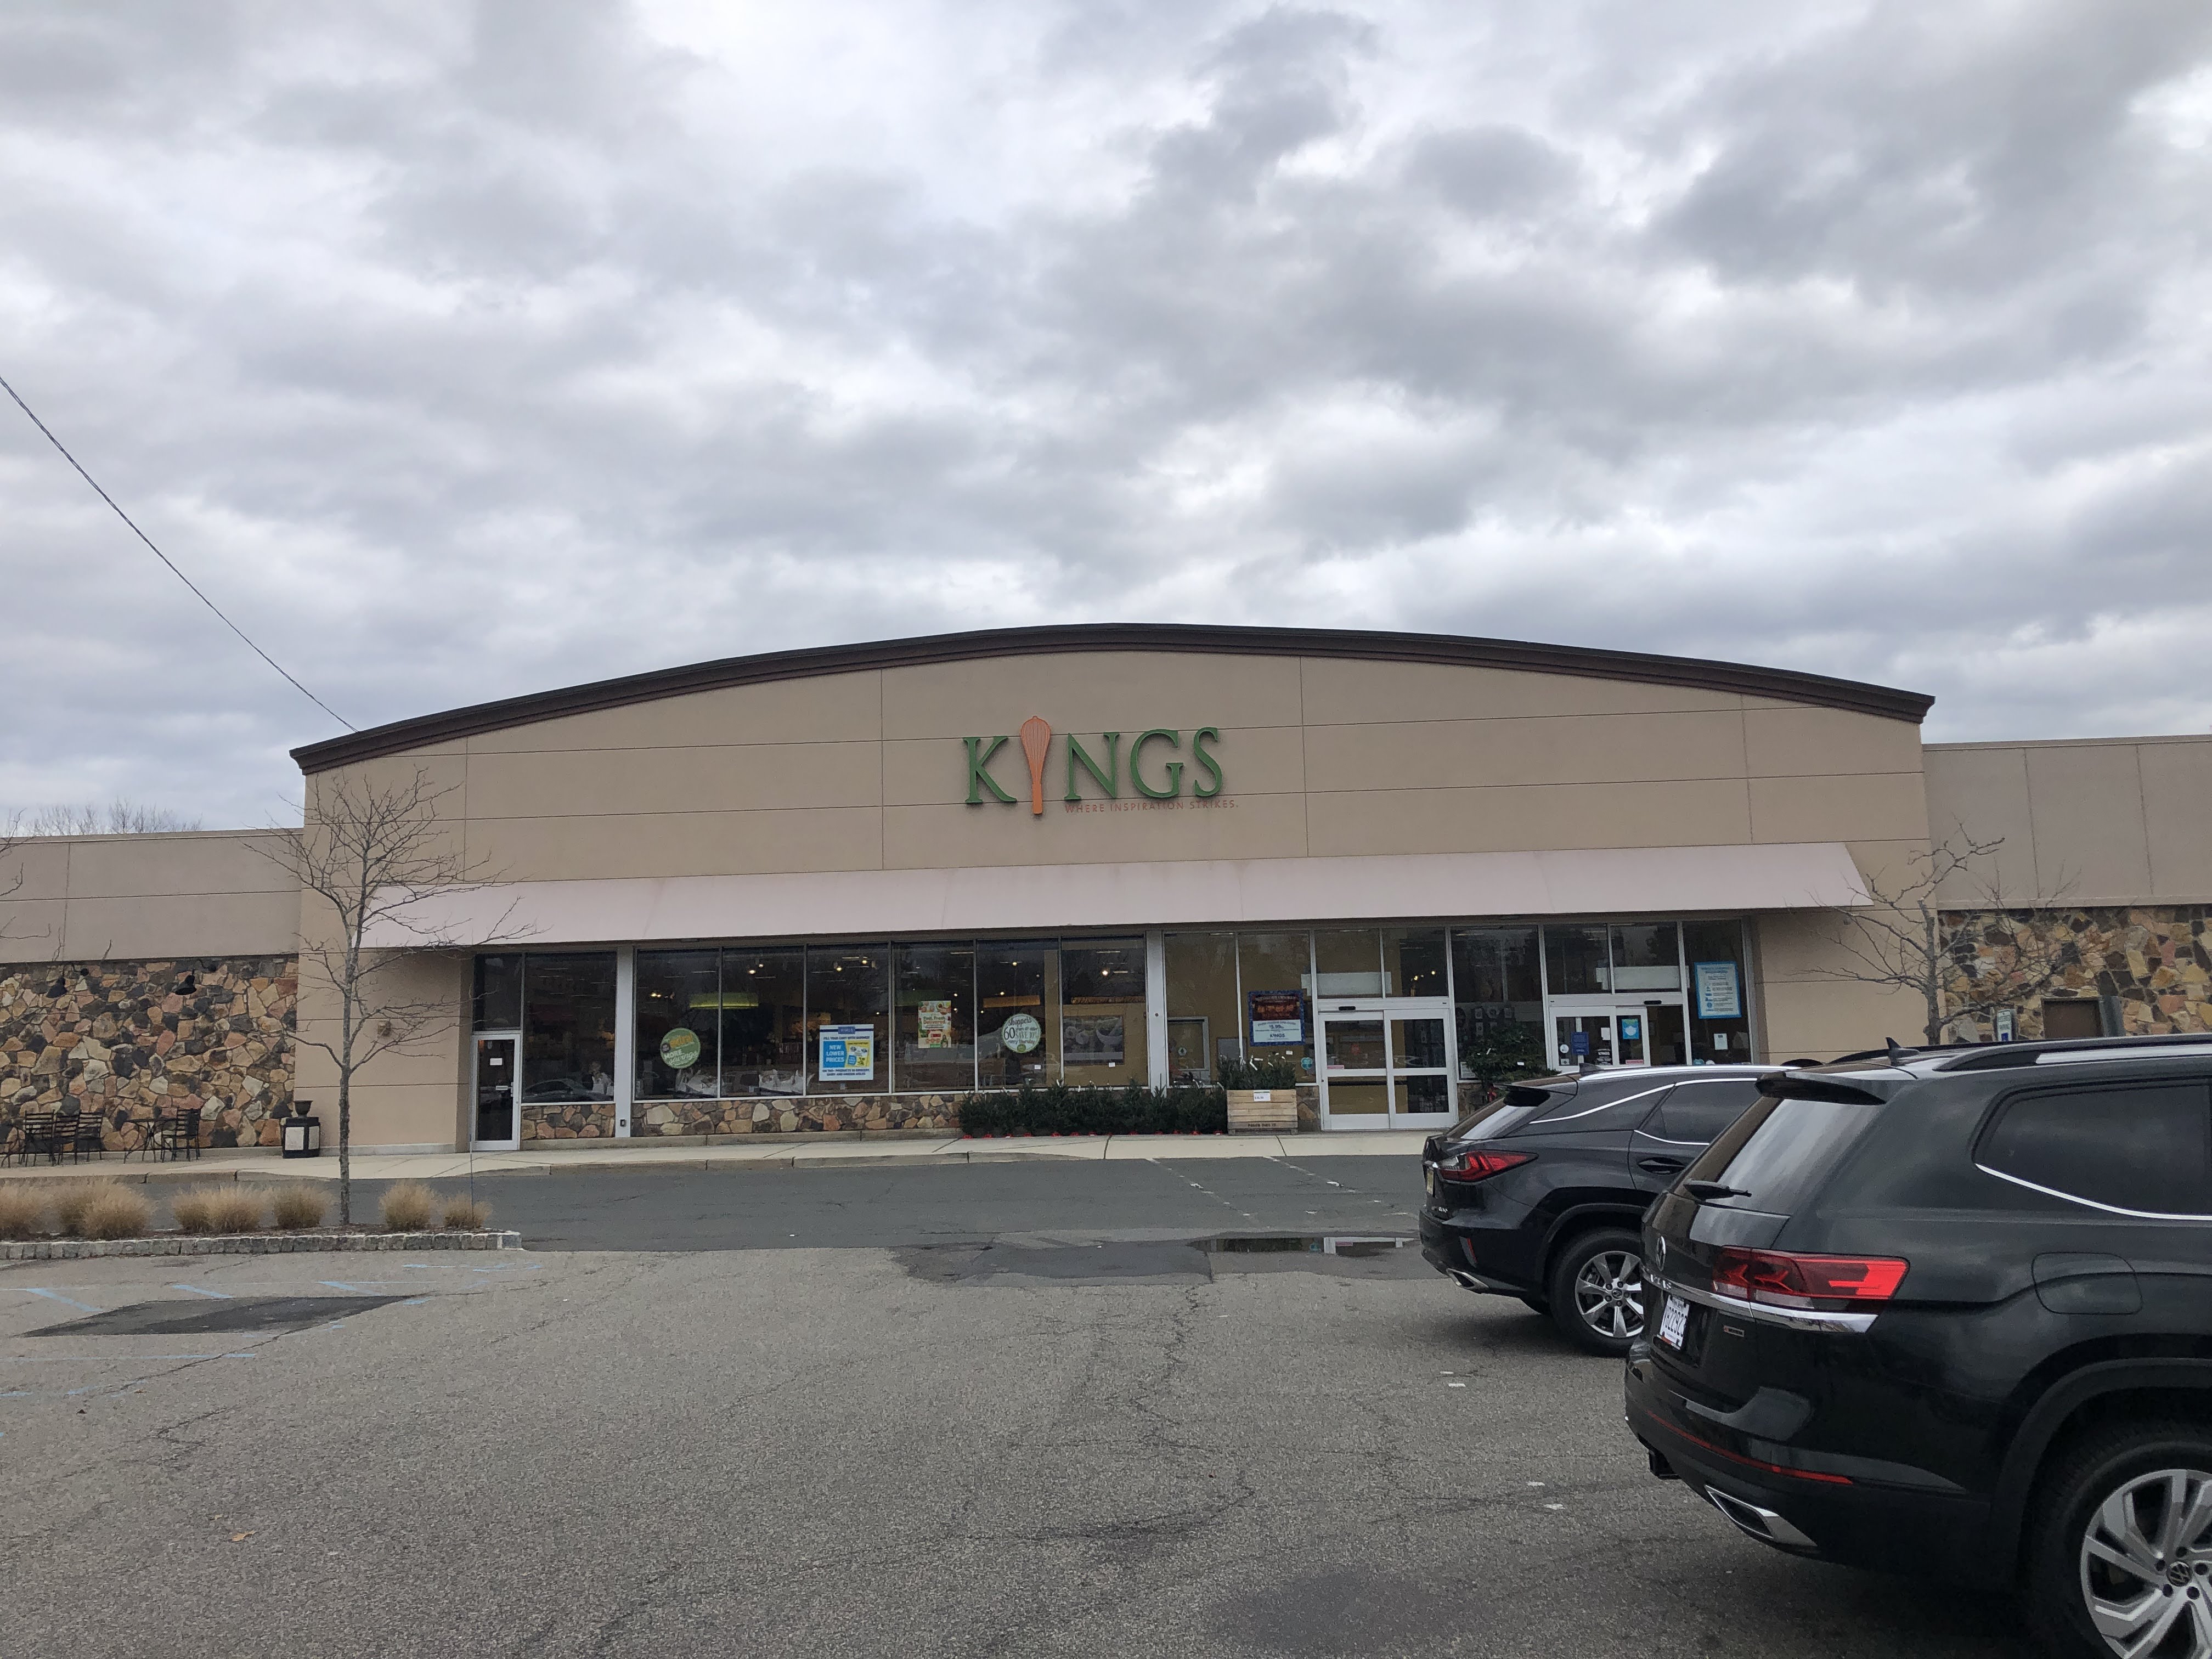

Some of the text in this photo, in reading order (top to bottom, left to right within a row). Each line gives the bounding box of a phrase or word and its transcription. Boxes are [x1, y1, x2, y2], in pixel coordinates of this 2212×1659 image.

[963, 715, 1222, 815] KINGS
[1065, 804, 1105, 813] WHERE
[1110, 801, 1184, 812] INSPIRATION
[1004, 1026, 1015, 1040] 60
[664, 1049, 684, 1060] MORE
